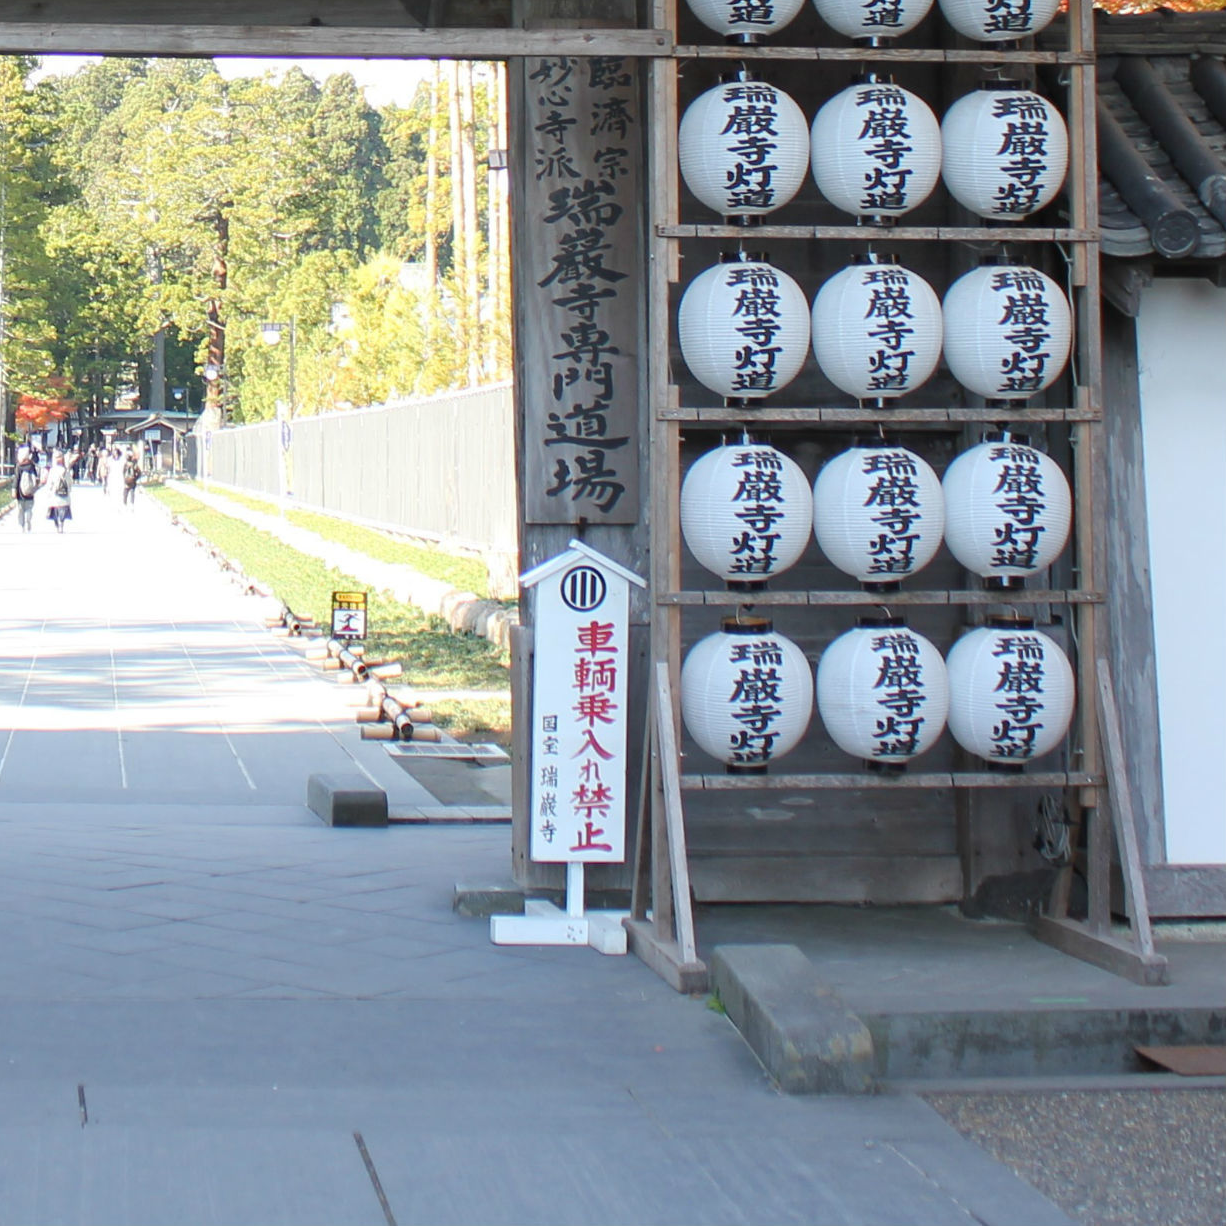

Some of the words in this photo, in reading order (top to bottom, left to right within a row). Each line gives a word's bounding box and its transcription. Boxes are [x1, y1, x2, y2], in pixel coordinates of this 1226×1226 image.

[528, 55, 582, 181] 妙心寺派
[542, 714, 558, 756] 国宝
[569, 620, 618, 852] 車輌乗入れ禁止
